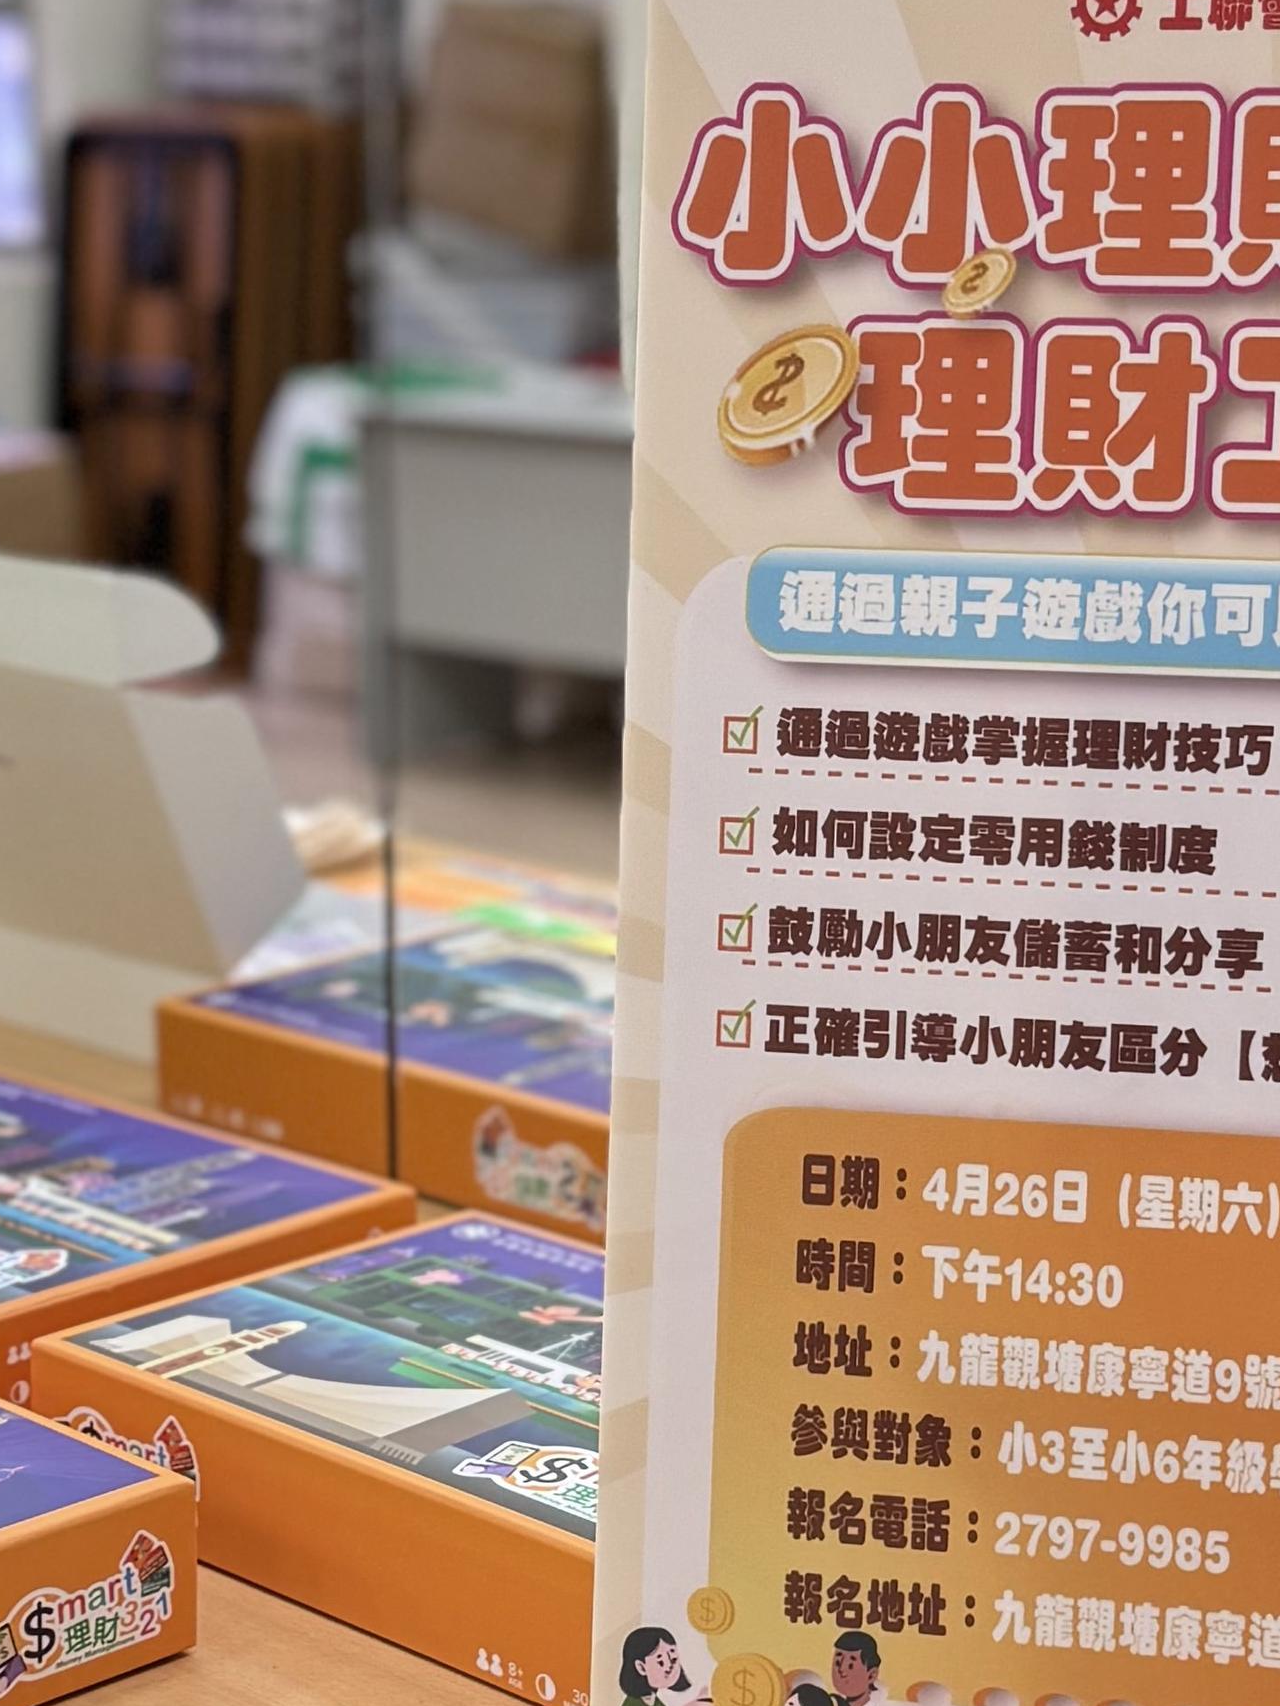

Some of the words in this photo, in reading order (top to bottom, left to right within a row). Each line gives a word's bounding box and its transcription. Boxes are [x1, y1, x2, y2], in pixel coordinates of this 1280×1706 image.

[776, 707, 1274, 776] 通過遊戲掌握理財技巧
[772, 806, 1219, 875] 如何設定零用錢制度
[767, 906, 1264, 979] 鼓勵小朋友儲蓄和分享
